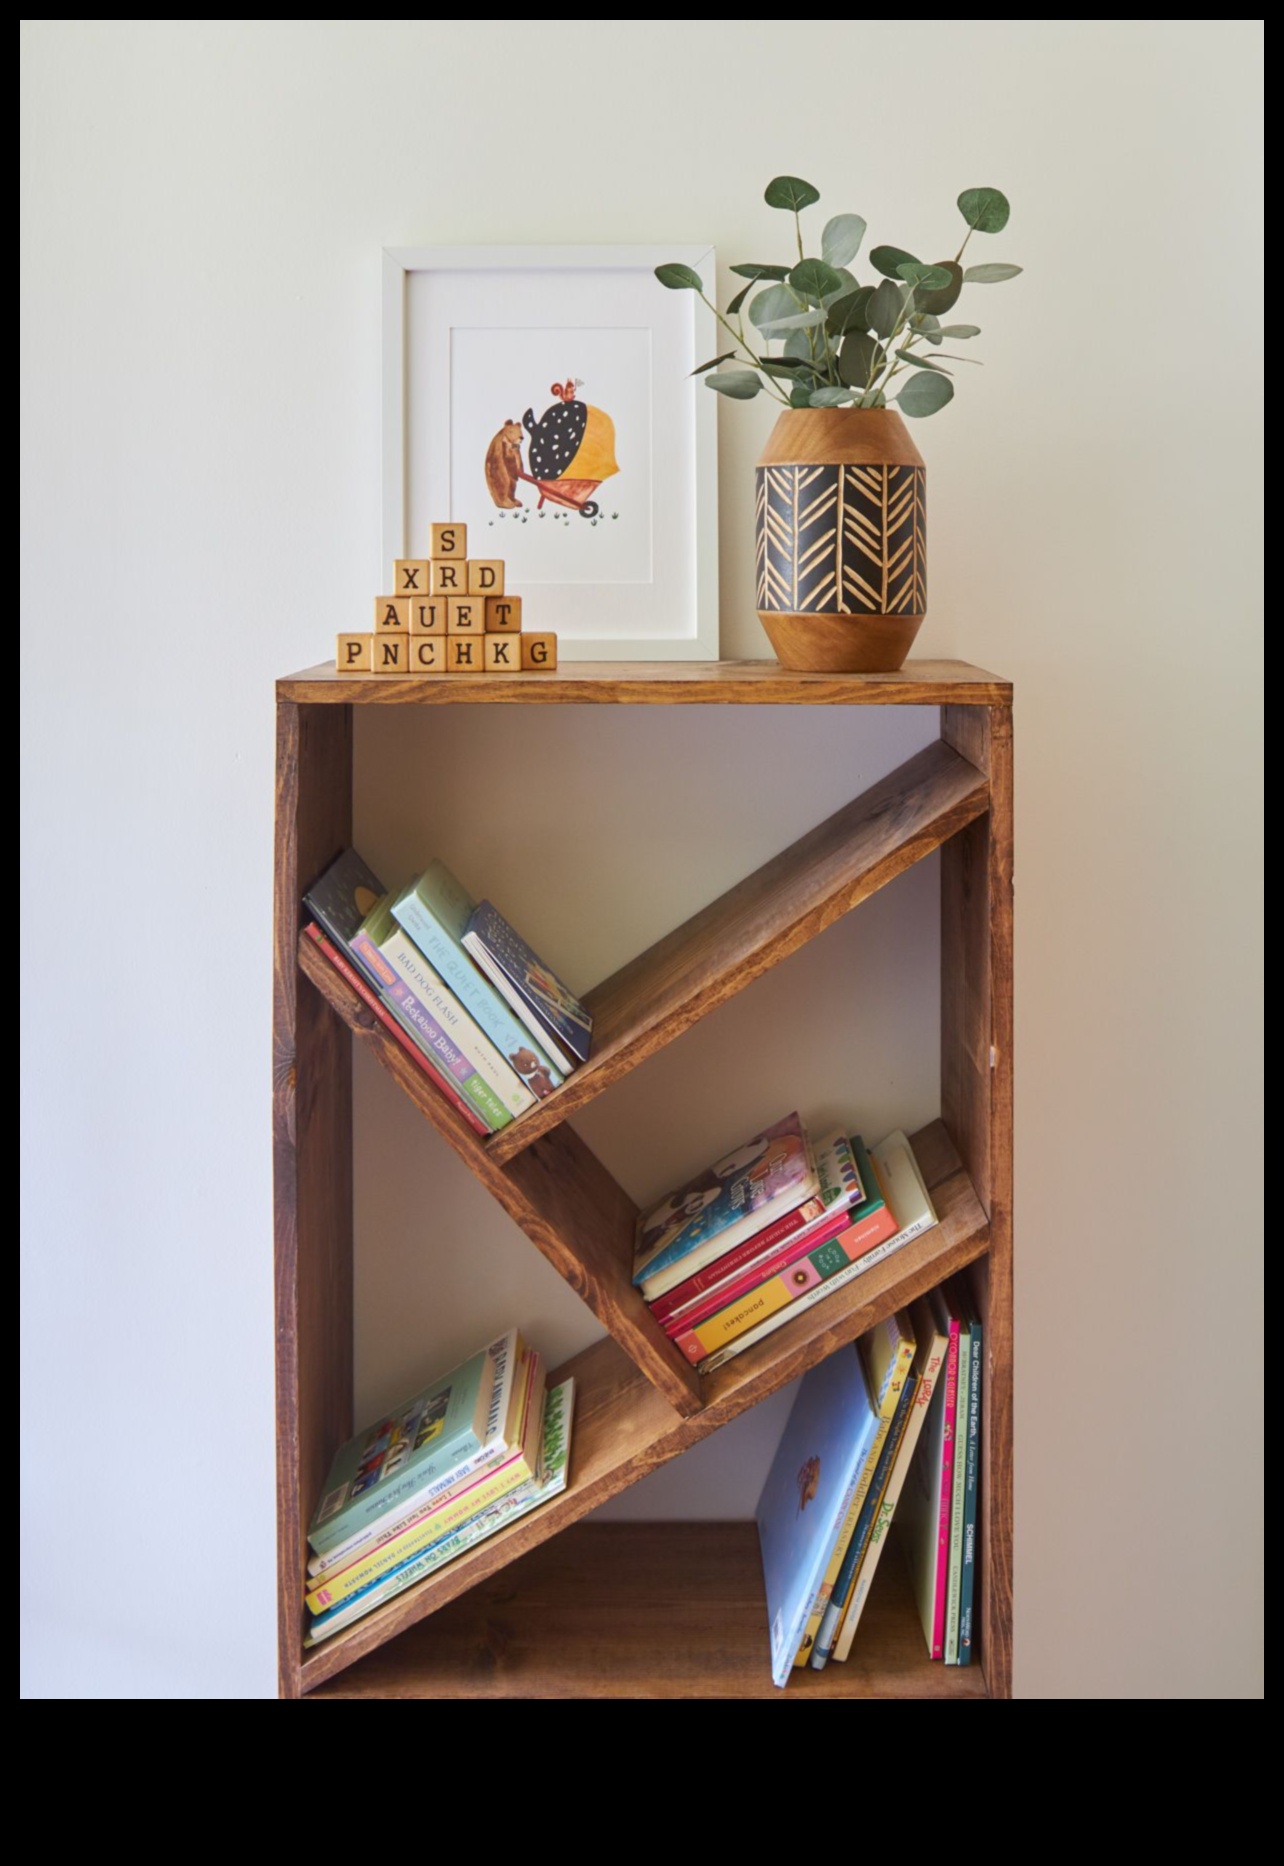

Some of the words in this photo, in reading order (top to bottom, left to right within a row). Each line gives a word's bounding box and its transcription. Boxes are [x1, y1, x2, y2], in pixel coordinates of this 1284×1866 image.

[441, 530, 455, 551] S
[403, 569, 419, 589] X
[440, 567, 457, 587] R
[479, 567, 495, 588] D
[383, 605, 400, 625] A
[419, 606, 435, 627] U
[457, 606, 472, 626] E
[496, 604, 511, 625] T
[347, 643, 362, 663] P
[382, 644, 399, 665] N
[418, 643, 434, 665] C
[456, 643, 472, 664] H
[493, 643, 509, 663] K
[531, 642, 547, 663] G
[332, 954, 345, 969] BABY
[360, 987, 385, 1016] CHRISTMAS
[396, 951, 417, 974] BAD
[412, 972, 435, 996] DOG
[431, 994, 459, 1026] FLASH
[426, 934, 449, 960] THE
[444, 958, 480, 1000] QUIET
[476, 997, 505, 1030] BOOK
[432, 1035, 461, 1067] Baby!
[468, 1079, 488, 1100] tiger
[484, 1097, 503, 1117] tales
[907, 1222, 922, 1235] The
[885, 1231, 908, 1249] Mouse
[862, 1245, 887, 1265] Family
[828, 1273, 845, 1287] with
[844, 1264, 859, 1277] Fun
[806, 1283, 830, 1302] Words
[721, 1297, 765, 1332] pancakes!
[927, 1354, 942, 1374] The
[947, 1332, 958, 1375] O'CONNOR
[971, 1359, 979, 1391] Children
[913, 1376, 935, 1409] LORAX
[945, 1381, 955, 1407] GLASSER
[971, 1392, 978, 1401] of
[874, 1414, 891, 1442] Baby
[969, 1415, 977, 1438] Earth,
[867, 1443, 879, 1464] AND
[453, 1464, 471, 1479] BABY
[966, 1459, 974, 1474] from
[427, 1474, 456, 1497] ANIMALS
[481, 1486, 499, 1499] LOVE
[851, 1466, 873, 1508] Toddler
[954, 1481, 962, 1504] MUCH
[418, 1504, 431, 1515] You
[431, 1494, 447, 1507] Love
[470, 1497, 481, 1507] MY
[877, 1499, 894, 1519] Dr.
[405, 1512, 419, 1524] Just
[442, 1505, 469, 1524] MOMMY
[832, 1510, 844, 1530] CANE
[391, 1520, 407, 1533] Like
[869, 1516, 891, 1545] Seuss
[436, 1535, 461, 1555] BEARS
[964, 1523, 974, 1564] SCHIMMEL
[372, 1552, 395, 1570] DANIEL
[424, 1551, 438, 1565] ON
[394, 1560, 425, 1583] WHEELS
